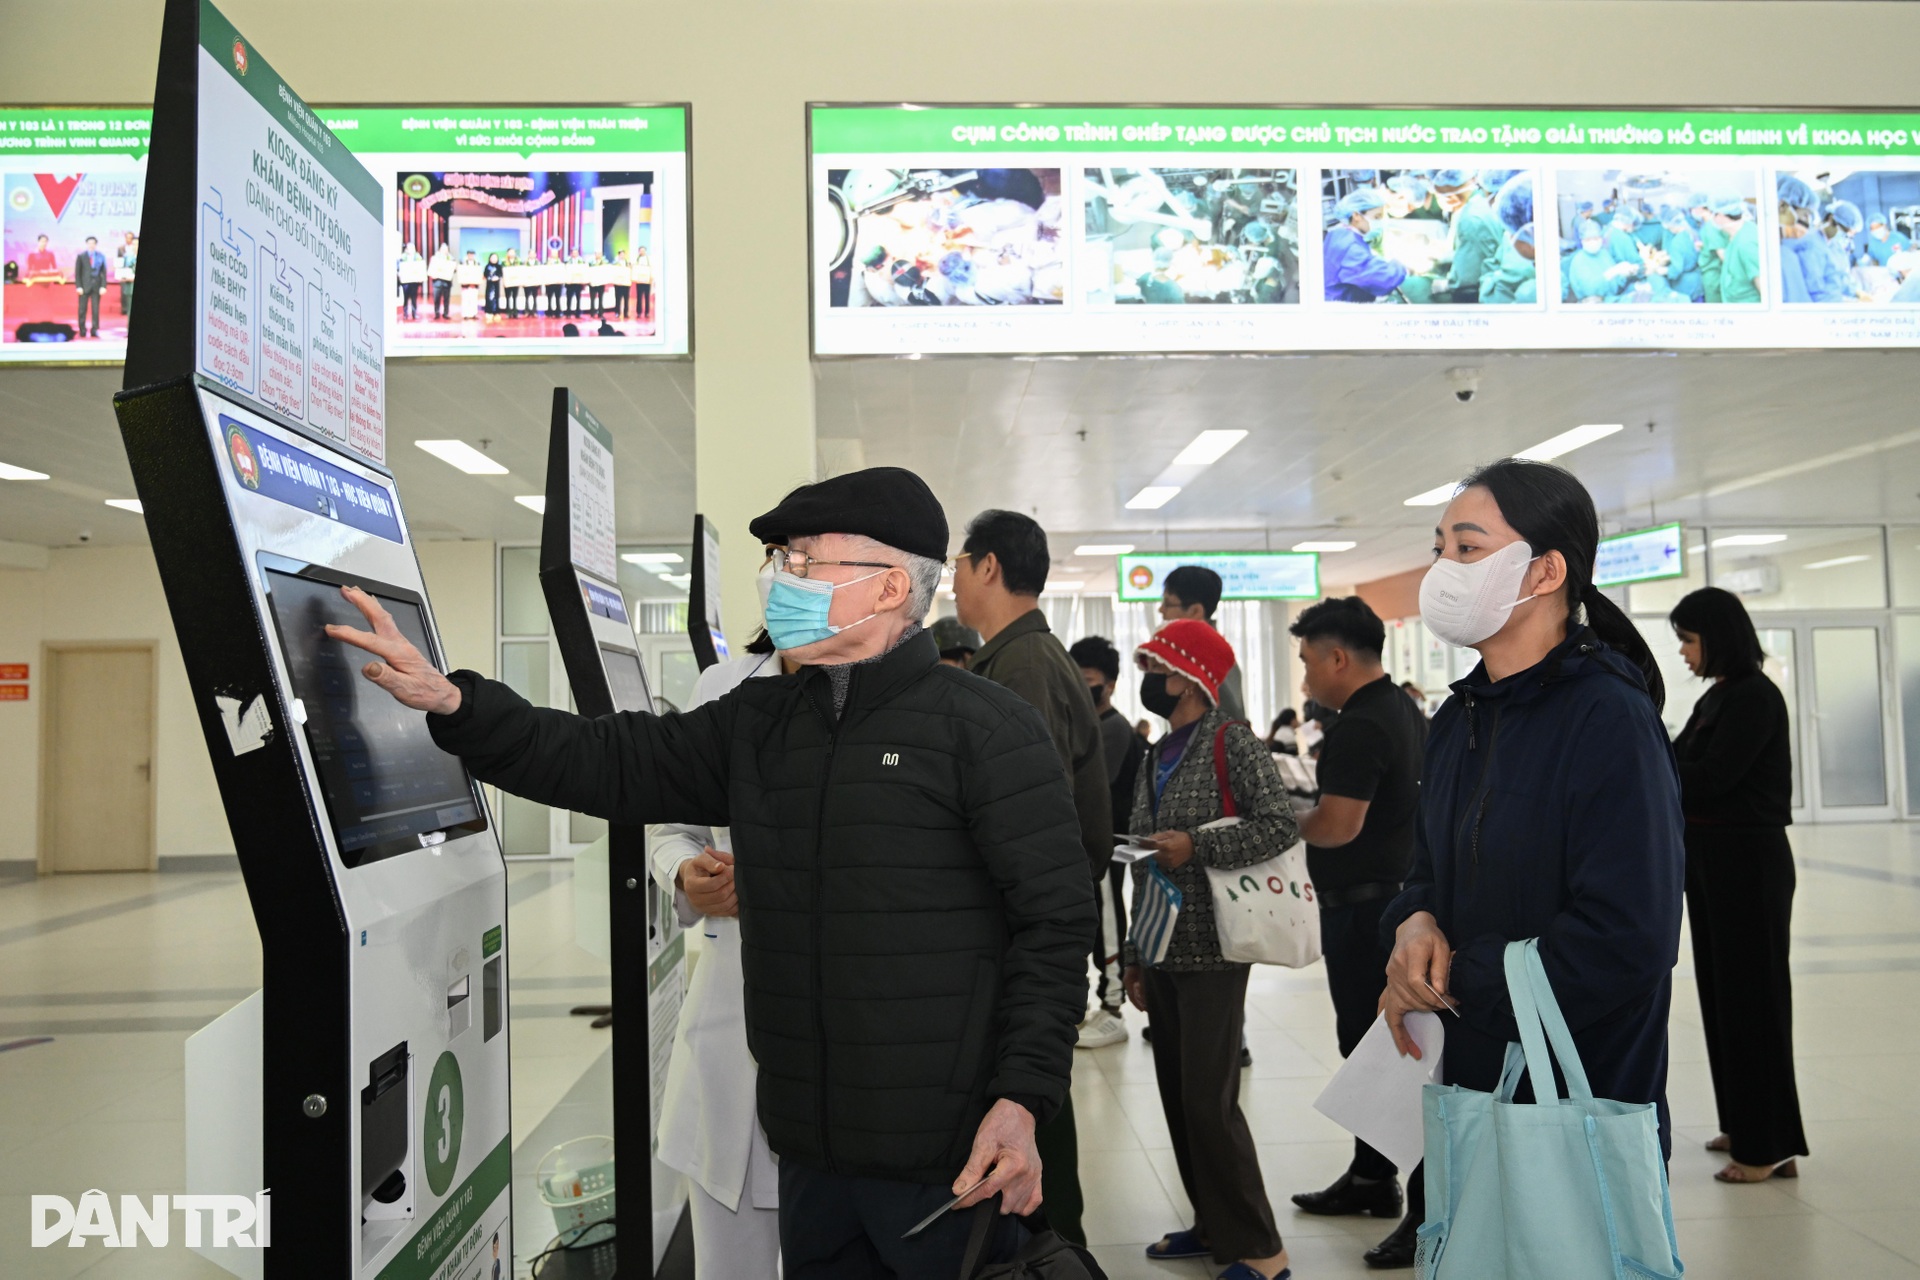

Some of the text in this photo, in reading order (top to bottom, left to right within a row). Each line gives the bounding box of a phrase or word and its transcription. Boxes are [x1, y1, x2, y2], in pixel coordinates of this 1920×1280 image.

[9, 118, 150, 131] Y 103 LÀ 1 TRONG 12 ĐƠN
[279, 84, 331, 147] BỆNH VIỆN QUÂN Y 103
[326, 119, 359, 130] DANH
[402, 117, 430, 131] BỆNH
[432, 117, 457, 131] VIỆN
[459, 117, 491, 130] QUÂN
[493, 119, 501, 130] Y
[503, 119, 523, 130] 103
[531, 117, 558, 131] BỆNH
[561, 117, 585, 131] VIỆN
[587, 118, 616, 130] THÂN
[618, 117, 648, 131] THIỆN
[34, 135, 66, 148] TRÌNH
[69, 137, 97, 148] VINH
[98, 137, 140, 148] QUANG
[455, 134, 467, 146] VÌ
[469, 134, 491, 146] SỨC
[525, 134, 559, 147] CỘNG
[561, 133, 595, 146] ĐỒNG
[951, 122, 1908, 150] CỤM CÔNG TRÌNH GHÉP TẠNG ĐƯỢC CHỦ TỊCH NƯỚC TRAO TẶNG GIẢI THƯỞNG HỒ CHÍ MINH VỀ KHOA HỌC
[268, 126, 338, 211] KIOSK ĐĂNG KÝ
[253, 149, 351, 255] KHÁM BỆNH TỰ ĐỘNG
[227, 218, 233, 241] 1
[246, 178, 356, 293] (DÀNH CHO ĐỐI TƯỢNG BHYT)
[210, 242, 247, 279] Quét CCCD
[280, 258, 286, 280] 2
[211, 267, 246, 302] /thẻ BHYT
[270, 283, 294, 312] Kiểm tra
[210, 290, 247, 326] /phiếu hẹn
[325, 292, 330, 312] 3
[269, 305, 295, 334] thông tin
[321, 320, 334, 340] Chọn
[364, 323, 368, 340] 4
[263, 323, 302, 360] trên màn hình
[313, 336, 342, 366] phòng khám
[257, 443, 283, 475] BỆNH
[280, 453, 301, 484] VIỆN
[299, 462, 322, 490] QUÂN
[319, 471, 327, 491] Y
[326, 475, 341, 497] 103
[342, 481, 358, 507] HỌC
[355, 485, 372, 512] VIỆN
[370, 493, 388, 516] QUÂN
[386, 500, 393, 518] Y
[1439, 590, 1459, 602] gumi
[438, 1084, 450, 1164] 3
[417, 1186, 473, 1260] BỆNH VIỆN QUÂN Y 103
[447, 1248, 462, 1279] KHÁM
[463, 1238, 468, 1259] TỰ
[470, 1223, 483, 1249] ĐỘNG
